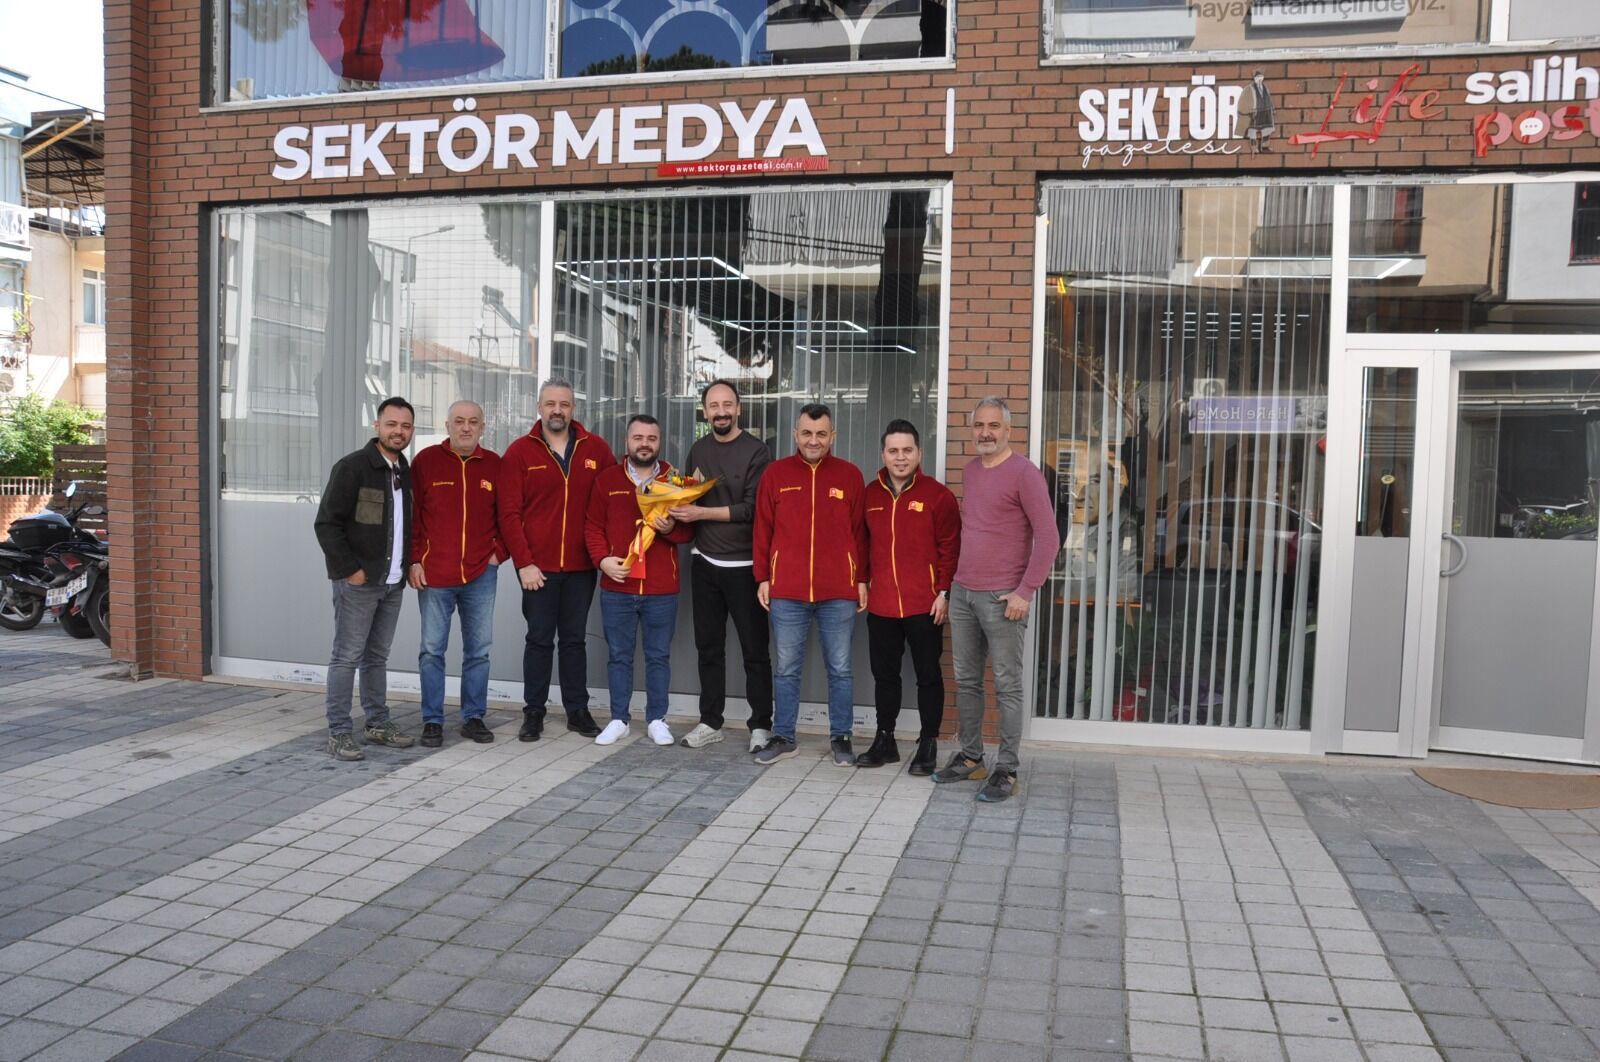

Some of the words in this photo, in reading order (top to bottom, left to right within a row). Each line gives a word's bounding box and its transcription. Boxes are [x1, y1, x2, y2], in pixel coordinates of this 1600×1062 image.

[1078, 75, 1244, 142] SEKTÖR
[1287, 63, 1446, 160] Life
[1464, 55, 1600, 104] salih
[272, 97, 540, 181] SEKTÖR
[552, 98, 828, 167] MEDYA
[676, 160, 804, 173] www.sektorgazetesi.com.tr
